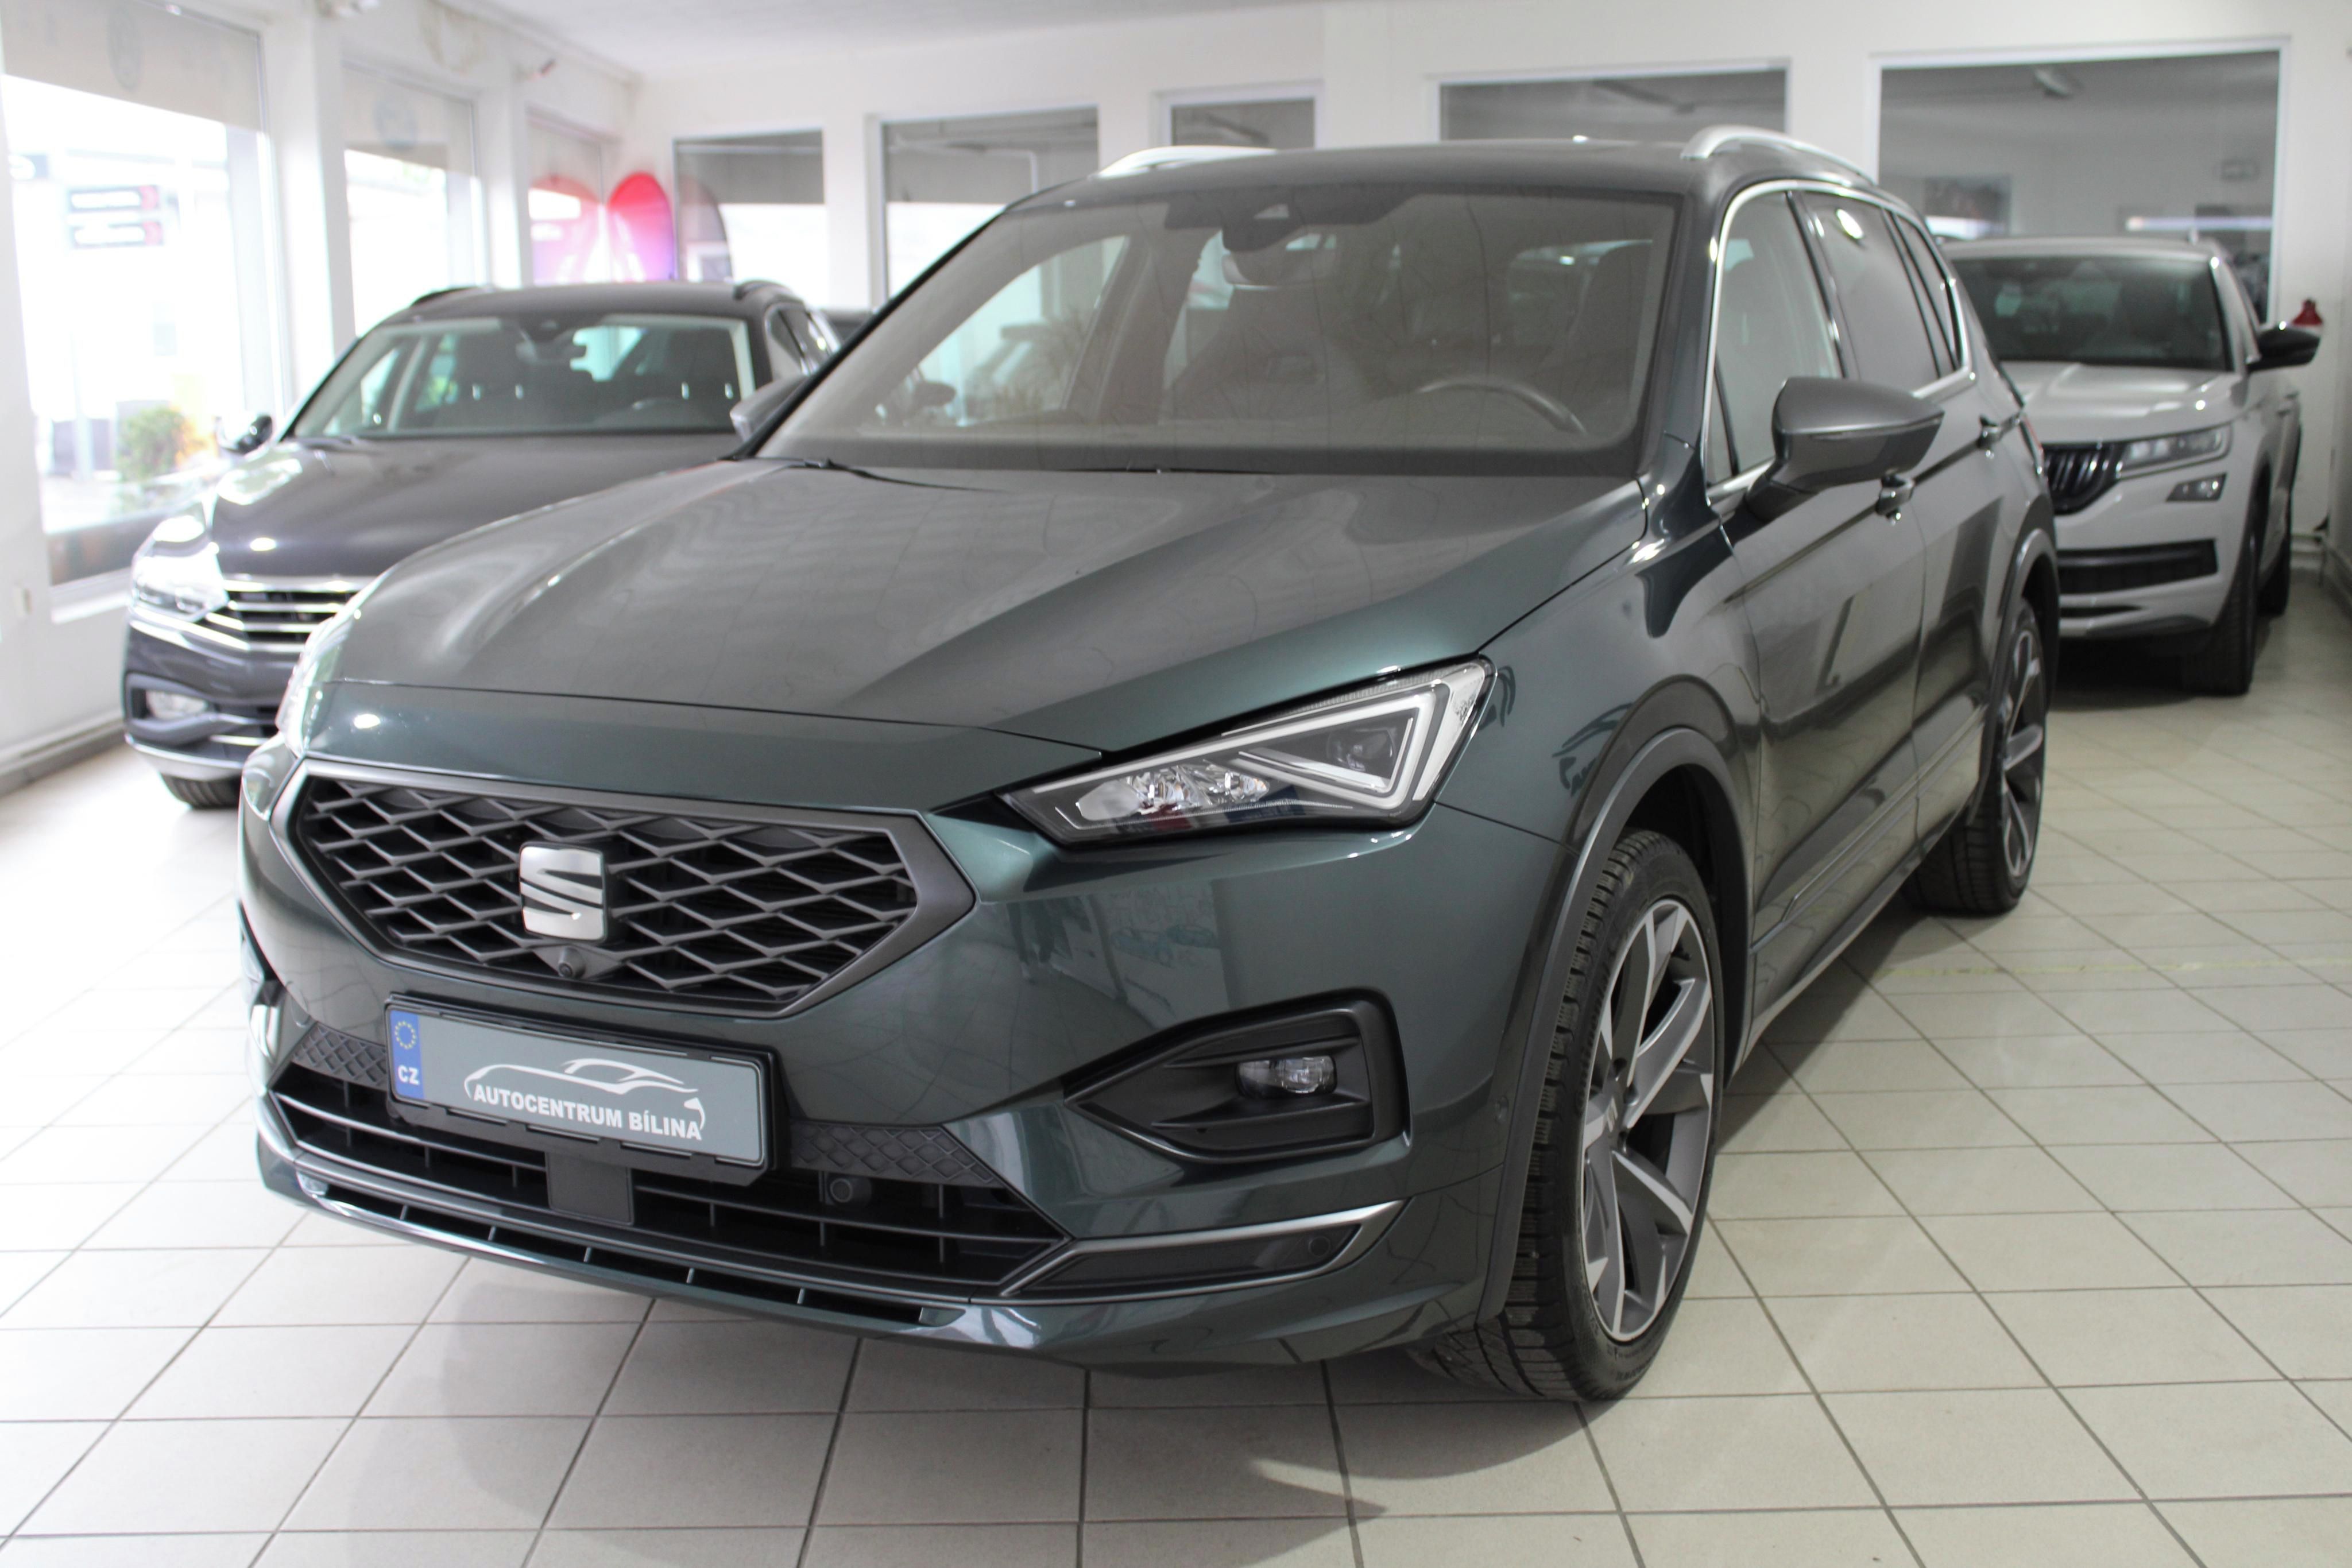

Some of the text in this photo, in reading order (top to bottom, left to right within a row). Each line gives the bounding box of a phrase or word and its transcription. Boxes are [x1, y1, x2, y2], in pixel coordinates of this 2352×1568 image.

[397, 1064, 420, 1085] CZ
[473, 1084, 702, 1141] AUTOCENTRUM BÍLINA
